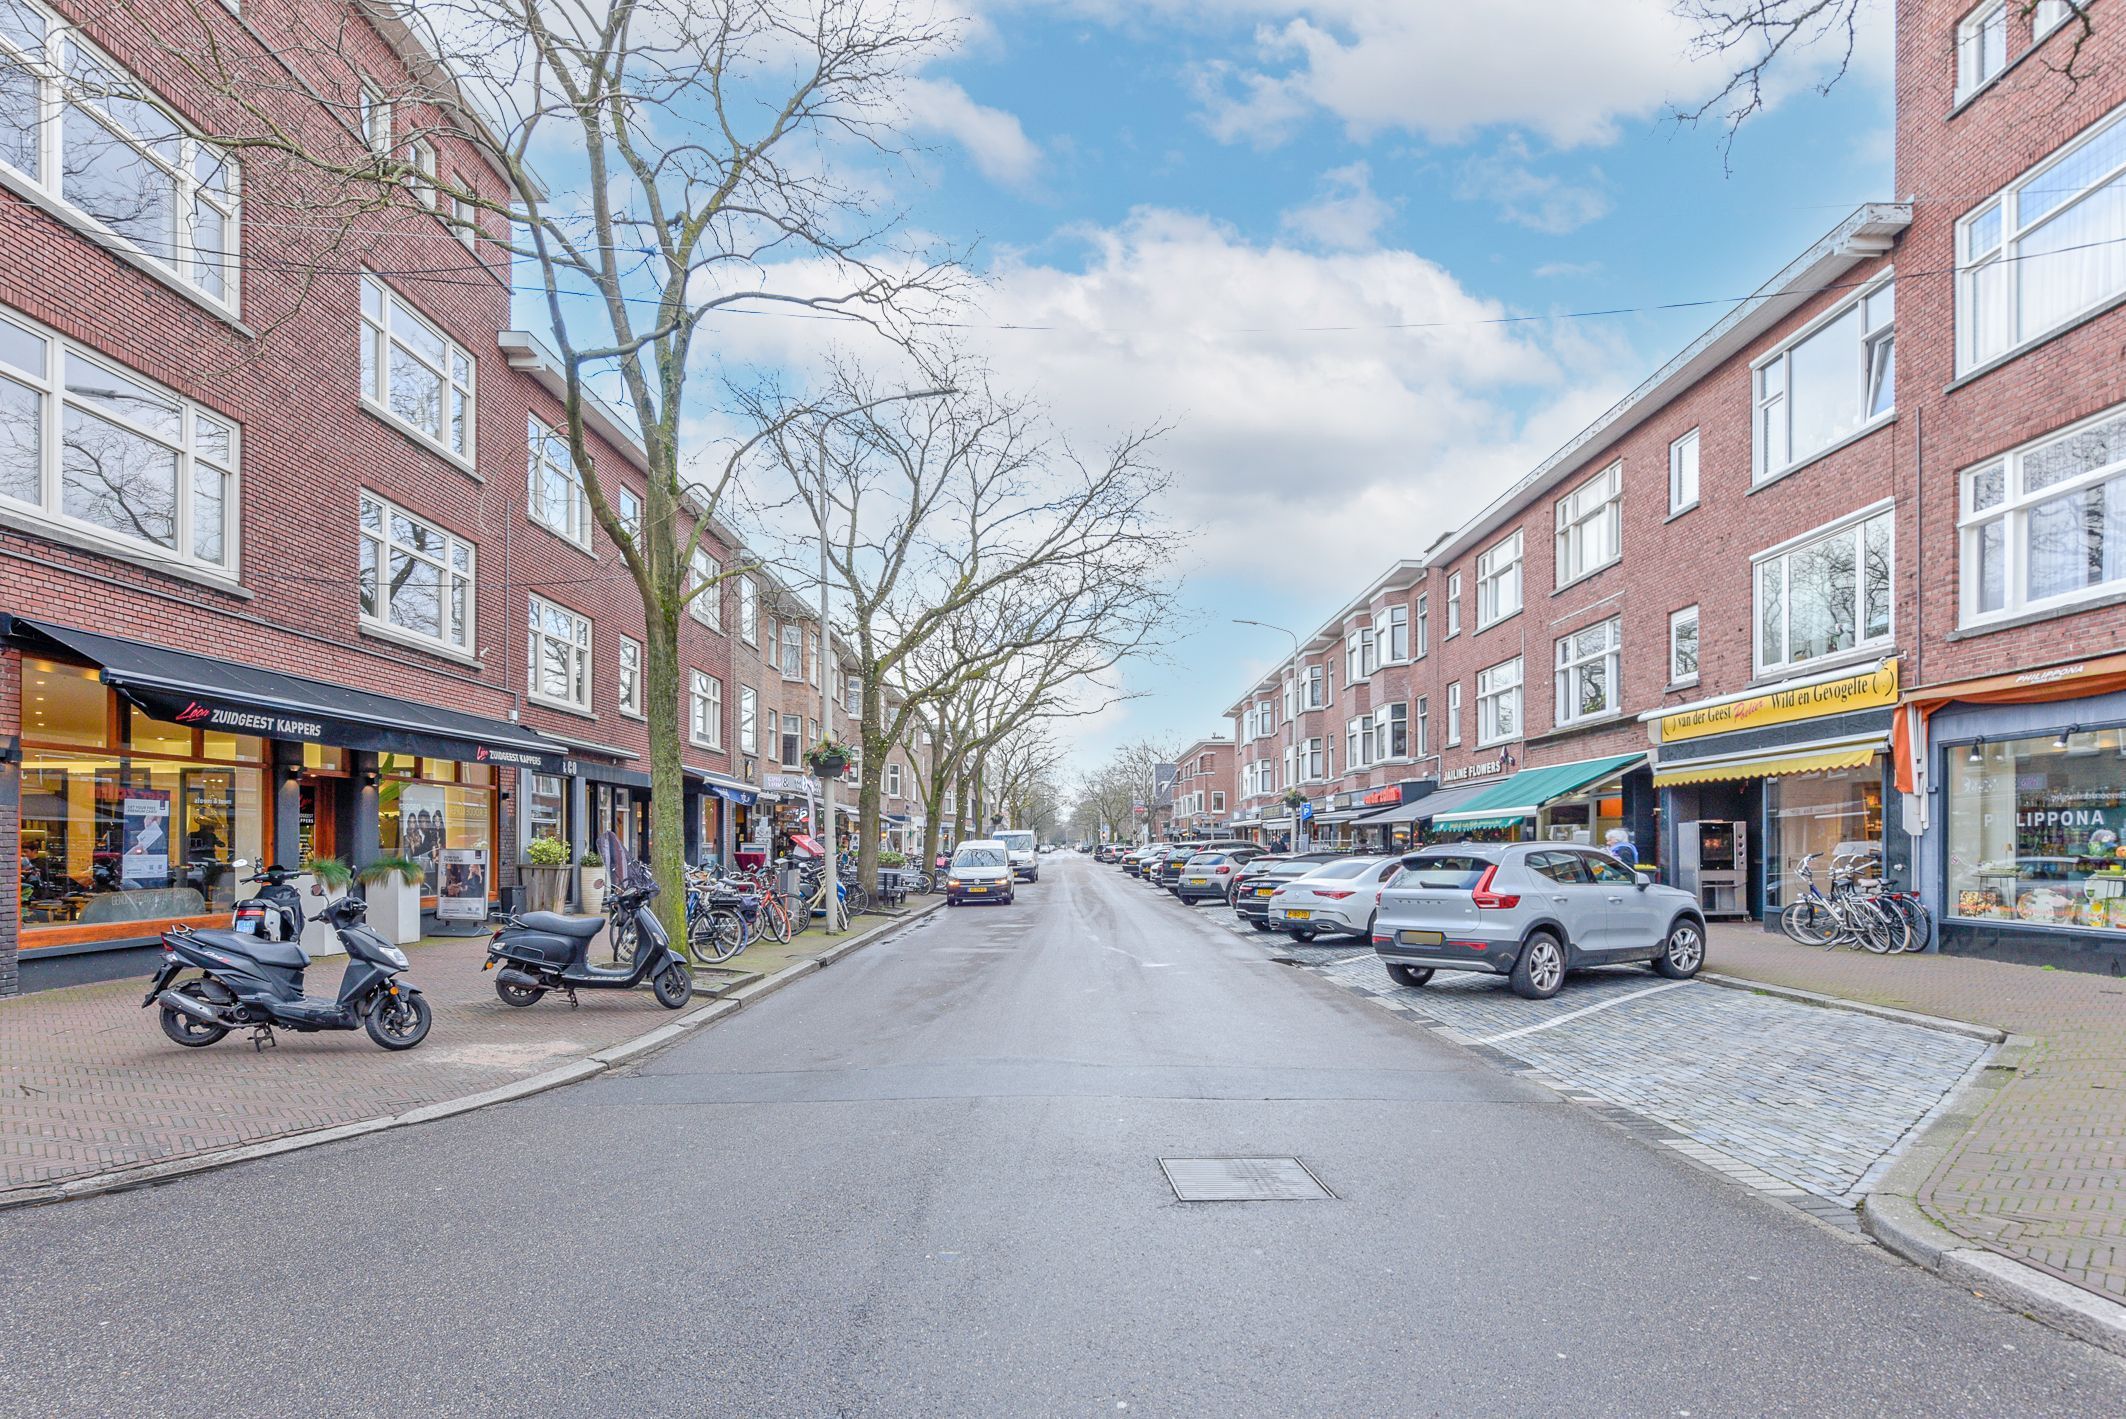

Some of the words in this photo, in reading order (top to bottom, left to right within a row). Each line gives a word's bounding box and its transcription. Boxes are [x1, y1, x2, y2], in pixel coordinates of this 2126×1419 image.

[2016, 665, 2084, 683] PHILIPPONA
[1678, 714, 1692, 728] van
[1693, 710, 1706, 726] der
[1708, 708, 1732, 723] Geest
[1771, 692, 1795, 710] Wild
[1798, 692, 1810, 706] en
[1813, 677, 1868, 703] Gevogelte
[211, 709, 275, 731] ZUIDGEEST
[277, 719, 322, 737] KAPPERS
[489, 750, 519, 762] ZUIDGEEST
[519, 753, 542, 766] KAPPERS
[568, 761, 577, 775] CO
[1469, 761, 1501, 777] FLOWERS
[1984, 810, 2104, 827] PLIPPONA
